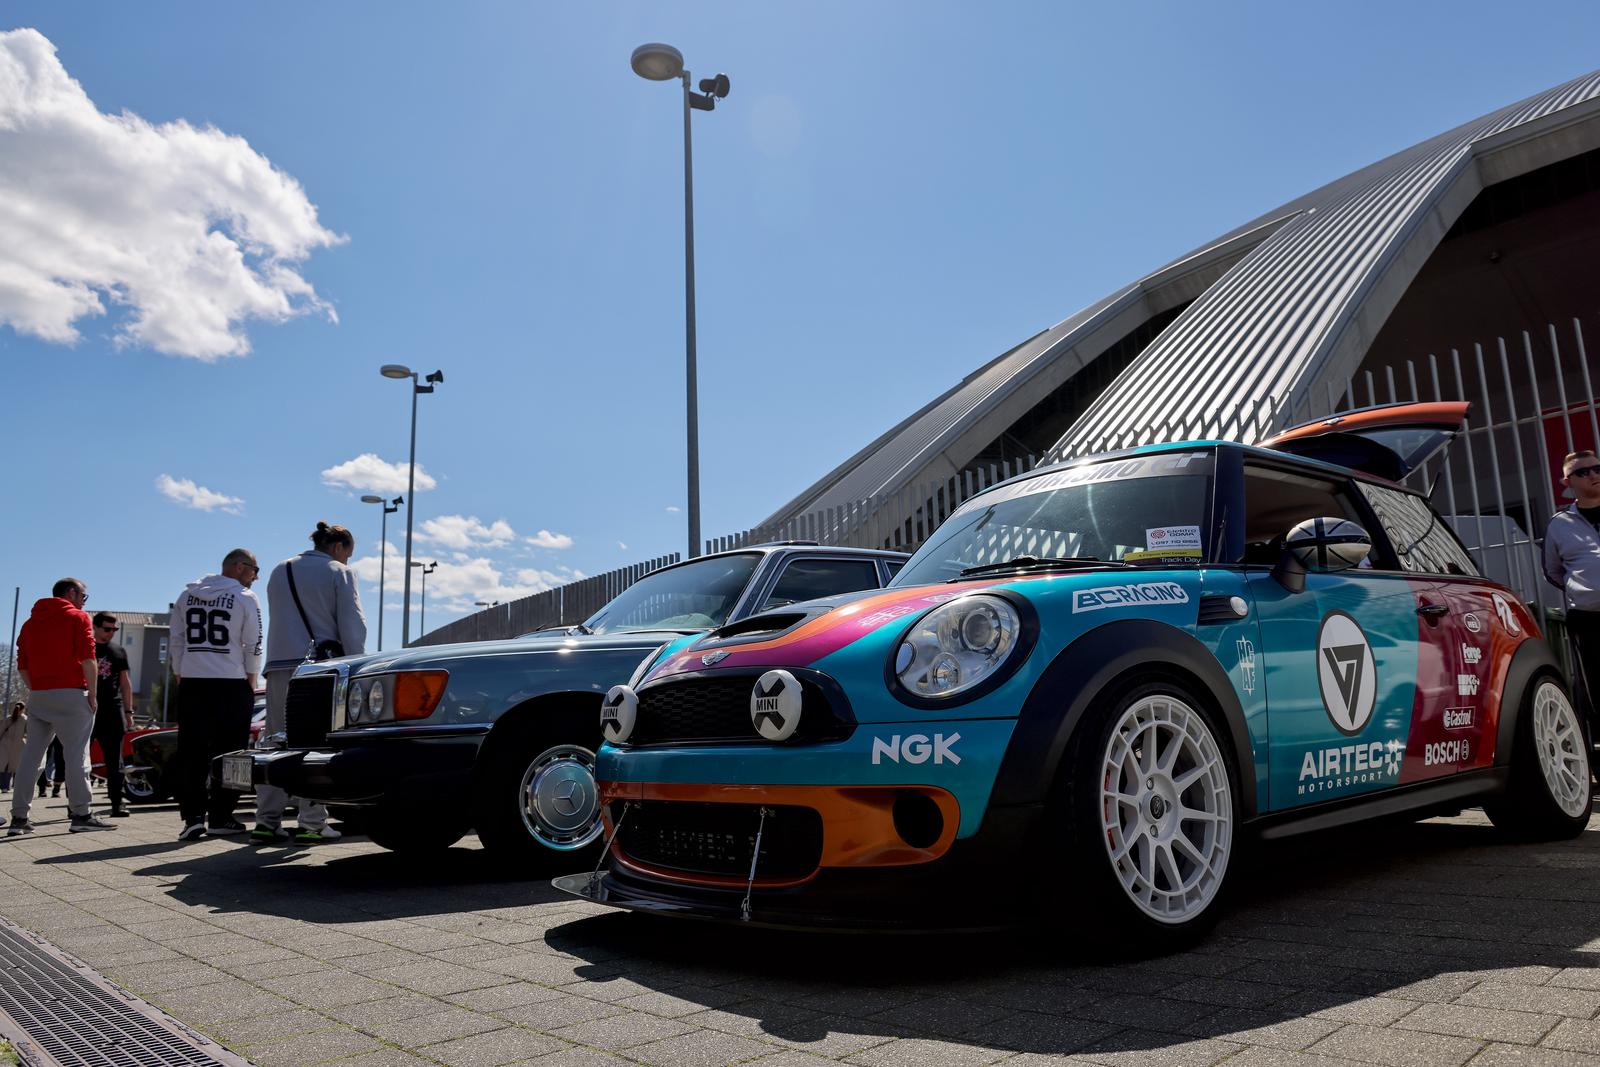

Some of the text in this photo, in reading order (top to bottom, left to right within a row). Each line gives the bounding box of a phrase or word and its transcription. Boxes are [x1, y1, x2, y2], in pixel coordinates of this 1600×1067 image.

[186, 607, 231, 646] 86
[603, 706, 618, 718] MINI
[756, 698, 778, 711] MINI
[871, 732, 962, 765] NGK
[1299, 741, 1383, 781] AIRTEC
[1424, 740, 1460, 766] BOSCH
[1298, 771, 1382, 795] MOTORSPORT
